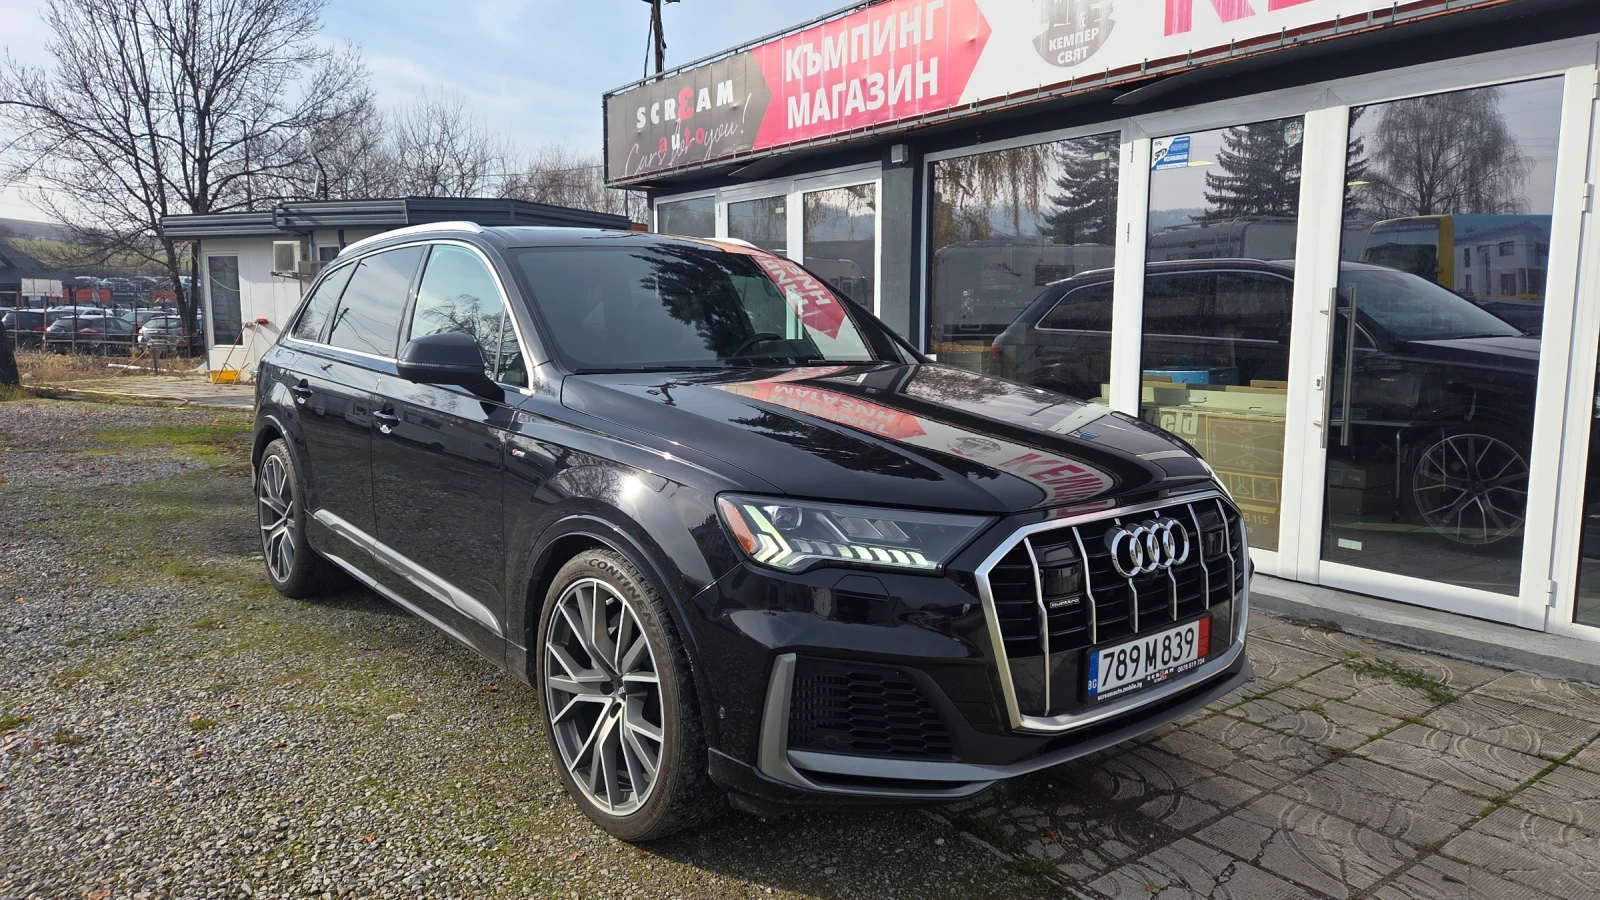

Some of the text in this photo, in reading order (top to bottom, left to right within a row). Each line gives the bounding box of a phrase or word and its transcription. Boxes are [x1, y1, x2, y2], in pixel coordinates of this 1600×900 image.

[785, 0, 944, 82] КЪМПИНГ
[1048, 27, 1100, 52] КЕМПЕР
[1057, 46, 1089, 65] СВЯТ
[636, 79, 734, 129] SCREAM
[787, 56, 939, 130] МАГАЗИН
[624, 143, 666, 178] Cars
[1252, 514, 1269, 525] 115
